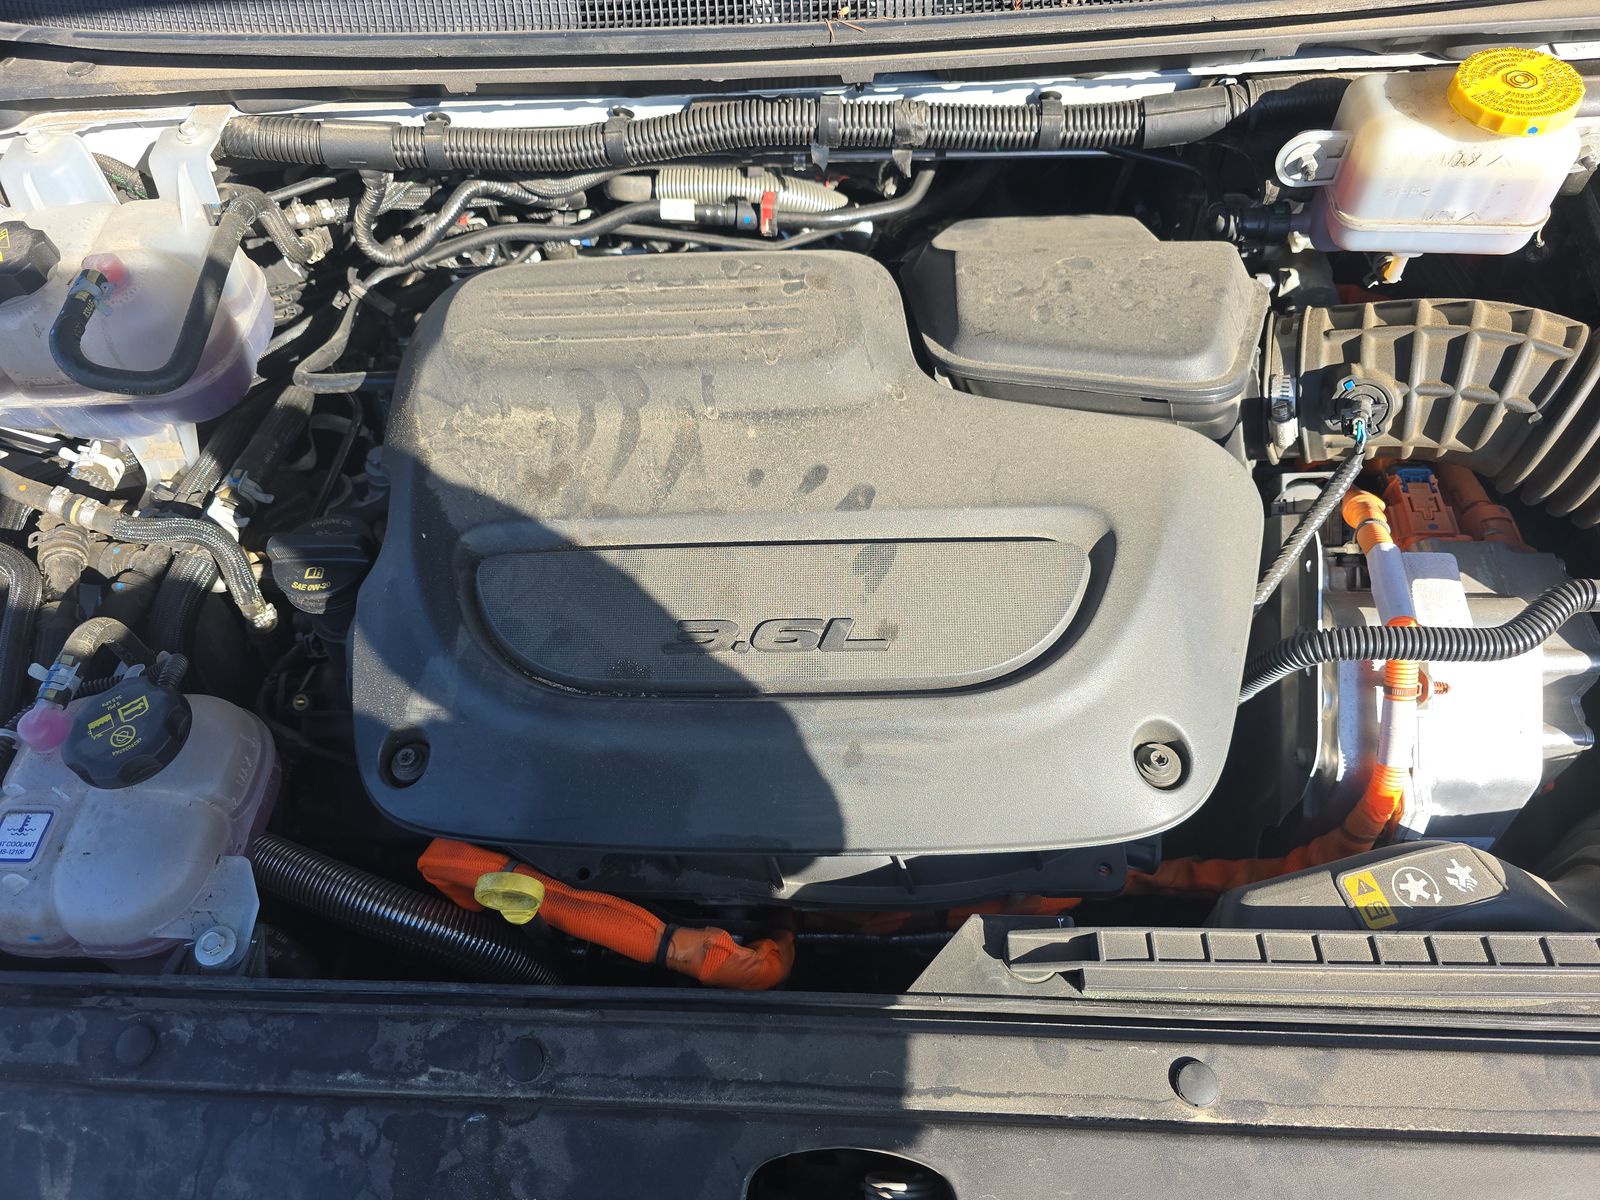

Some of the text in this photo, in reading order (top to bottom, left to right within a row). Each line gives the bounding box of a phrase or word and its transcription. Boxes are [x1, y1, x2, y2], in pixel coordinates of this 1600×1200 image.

[312, 519, 340, 528] ENGINE
[291, 581, 331, 591] SAE 0W-20
[661, 617, 892, 654] 3.6L
